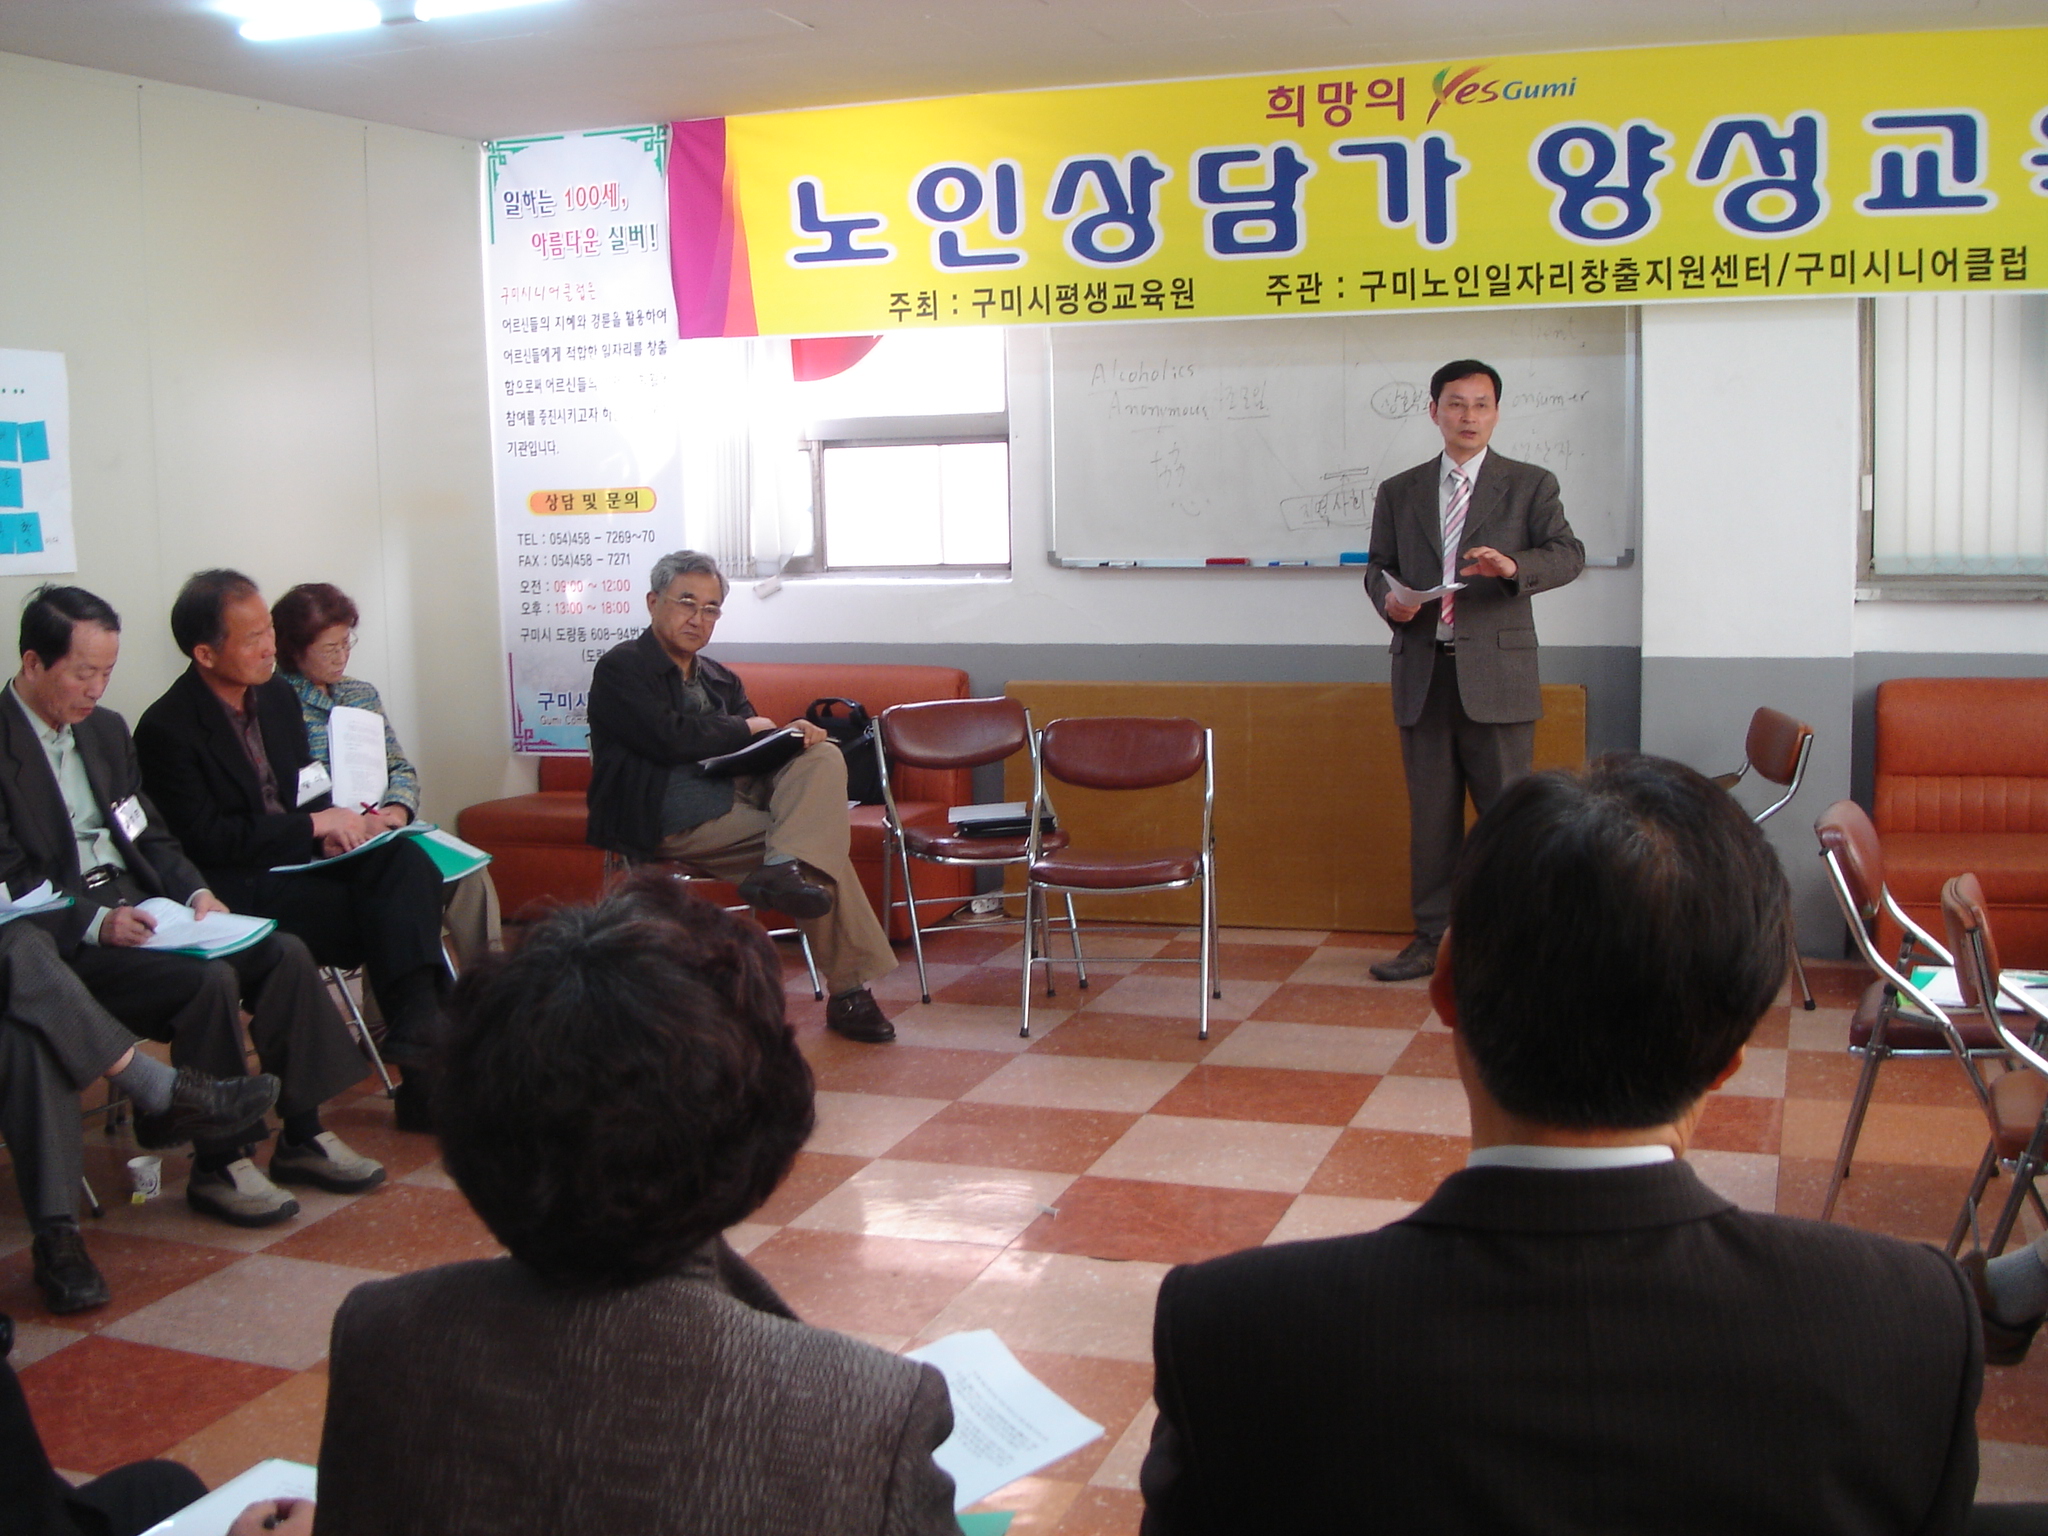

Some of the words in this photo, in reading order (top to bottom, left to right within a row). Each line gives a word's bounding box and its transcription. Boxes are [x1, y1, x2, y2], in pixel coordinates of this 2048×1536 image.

[1266, 77, 1405, 128] 희망의
[504, 189, 554, 216] 일하는
[564, 182, 627, 208] 100세,
[791, 134, 1463, 268] 노인상담가
[531, 227, 599, 257] 아름다운
[608, 223, 656, 251] 실버!
[889, 289, 939, 322] 주최
[971, 277, 1196, 319] 구미시평생교육원
[1265, 272, 1323, 307] 주관
[502, 315, 550, 334] 어르신들의
[503, 345, 561, 365] 어르신들에게
[602, 341, 642, 358] 일자리를
[1091, 357, 1195, 387] Alcoholics
[1511, 389, 1590, 409] onsumer
[505, 408, 536, 428] 참여를
[538, 406, 598, 426] 증진시키고자
[507, 439, 560, 458] 기관입니다.
[545, 493, 575, 512] 상담
[583, 492, 598, 511] 및
[605, 490, 639, 509] 문의
[517, 533, 539, 546] TEL
[518, 554, 540, 567] FAX
[607, 552, 632, 567] 7271
[520, 579, 542, 595] 오전
[601, 578, 631, 593] 12:00
[520, 600, 543, 616] 오후
[554, 601, 583, 615] 13:00
[601, 600, 631, 615] 18:00
[519, 627, 552, 642] 구미시
